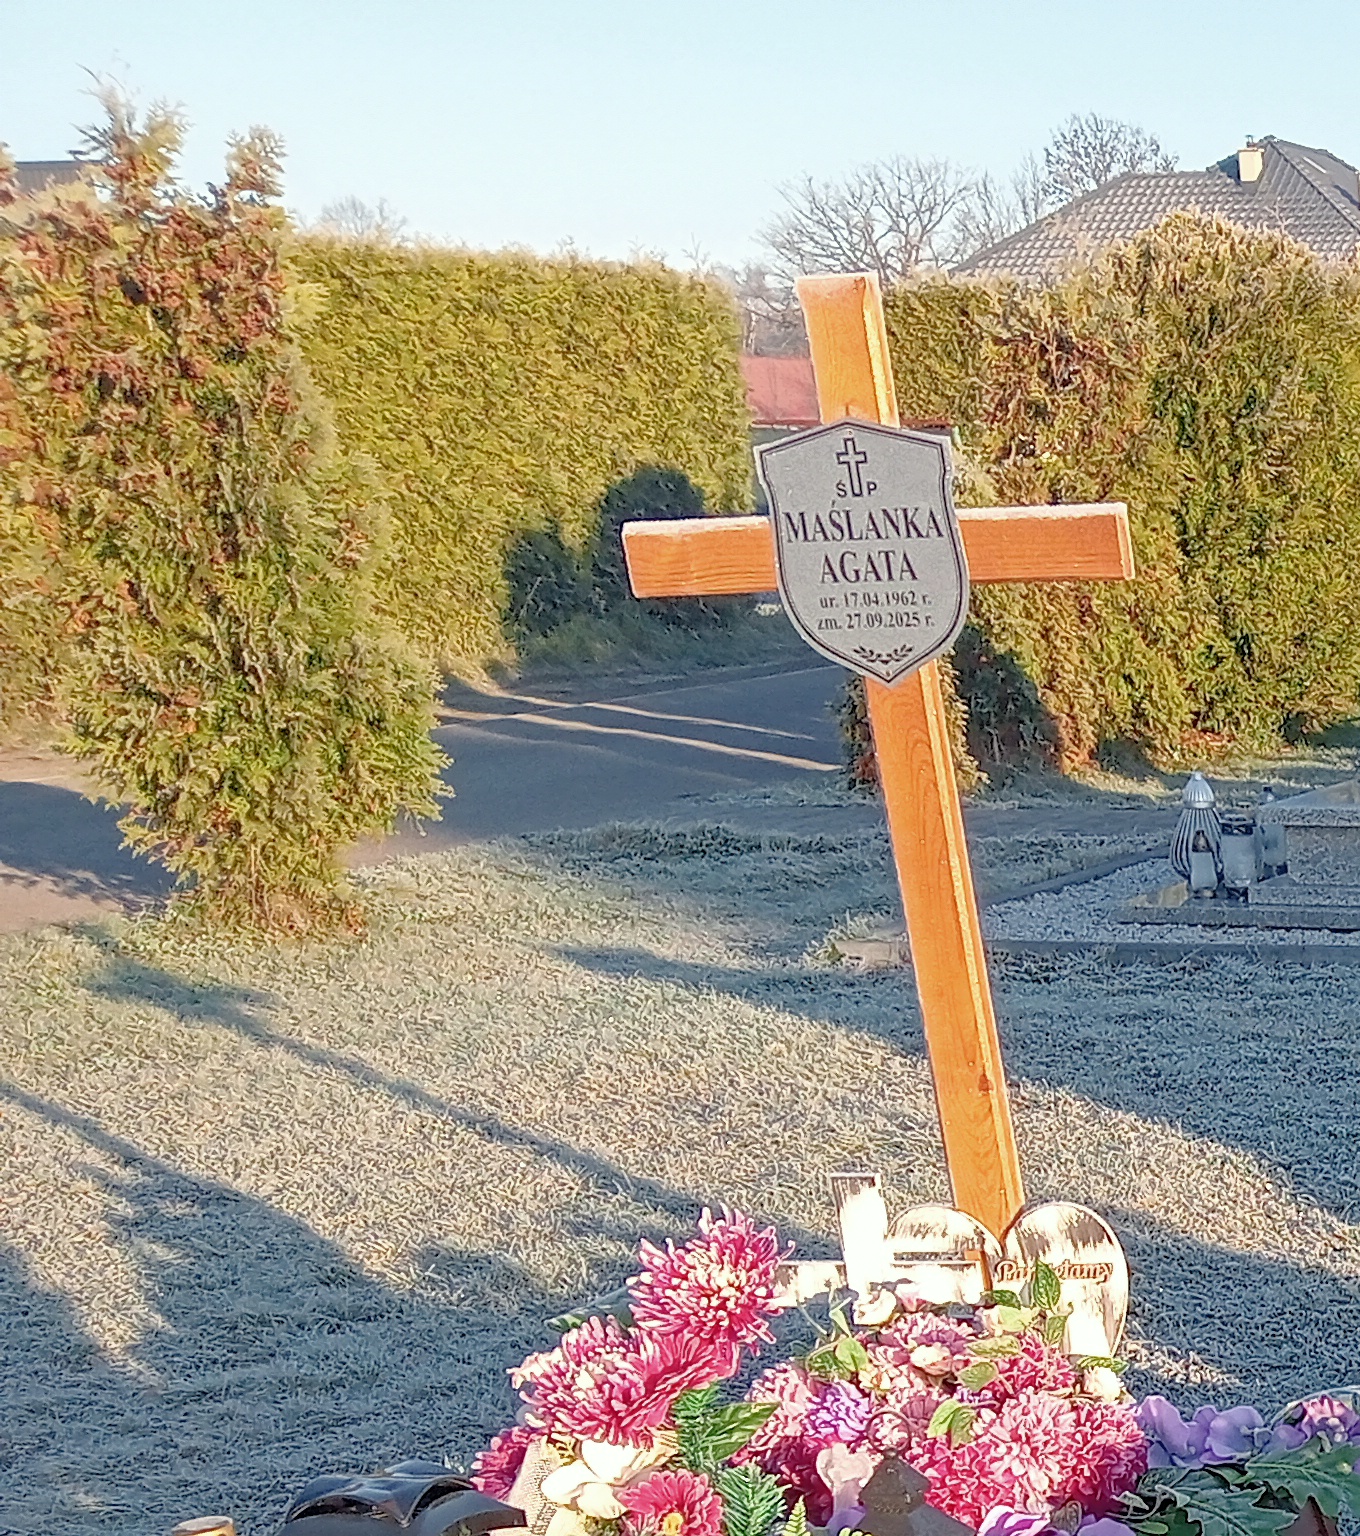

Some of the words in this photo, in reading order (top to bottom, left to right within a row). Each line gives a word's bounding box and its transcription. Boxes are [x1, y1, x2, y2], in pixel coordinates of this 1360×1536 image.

[782, 500, 944, 543] MAŚLANKA
[821, 550, 919, 583] AGATA
[819, 597, 839, 608] ur.
[843, 591, 916, 607] 17.04.1962
[818, 619, 842, 630] zm.
[846, 612, 921, 628] 27.09.2025
